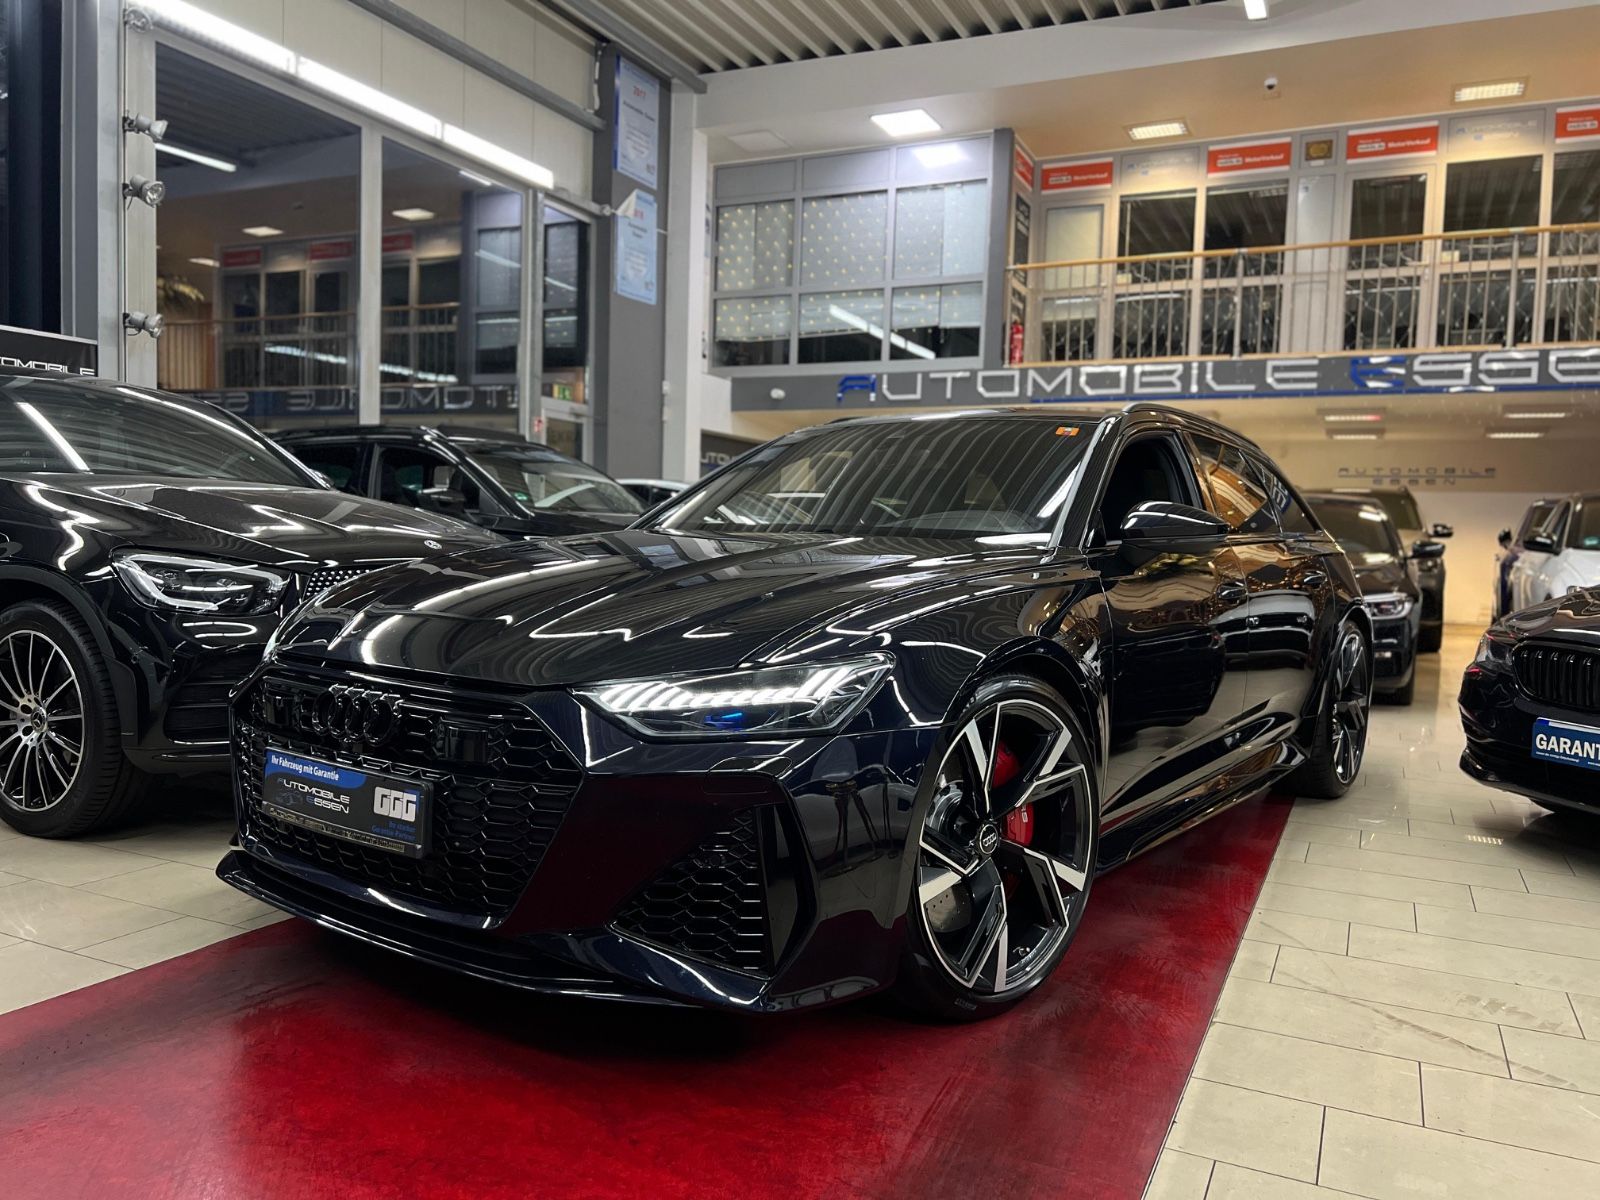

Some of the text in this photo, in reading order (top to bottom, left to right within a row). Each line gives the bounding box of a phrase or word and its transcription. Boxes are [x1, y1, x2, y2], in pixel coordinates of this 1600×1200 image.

[0, 357, 95, 376] OMOBILE
[837, 358, 1319, 403] AUTOMOBILE
[1338, 467, 1496, 475] AUTOMOBILE
[271, 755, 339, 781] Ihr Fahrzeug mit Garantie
[277, 778, 350, 804] AUTOMOBILE
[306, 795, 350, 814] ESSEN
